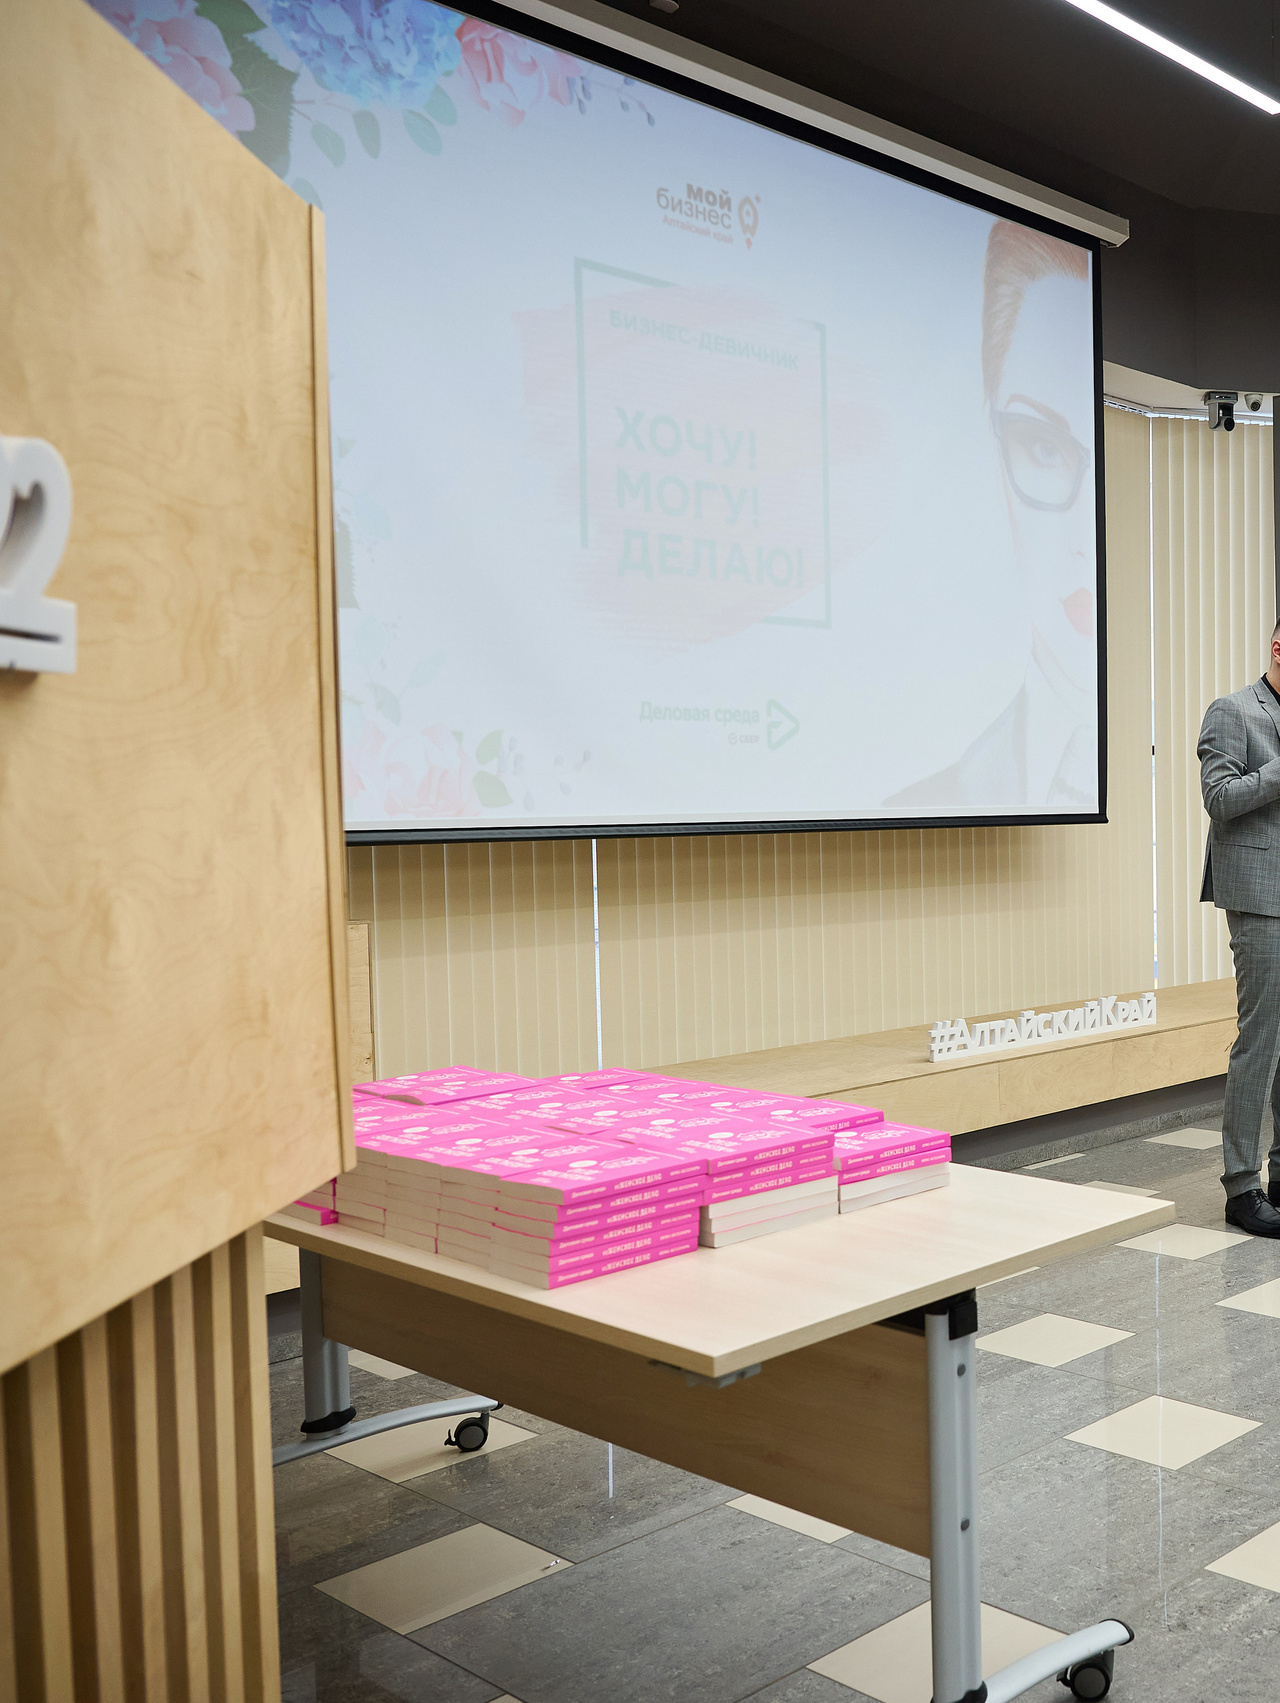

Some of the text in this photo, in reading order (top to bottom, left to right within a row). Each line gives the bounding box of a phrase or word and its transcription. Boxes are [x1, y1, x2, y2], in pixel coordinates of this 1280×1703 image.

[656, 187, 732, 229] бизнес
[614, 405, 757, 472] ХОЧУ!
[616, 466, 760, 528] МОГУ!
[616, 527, 805, 588] ДЕЛАЮ!
[639, 700, 760, 727] Деловая среда
